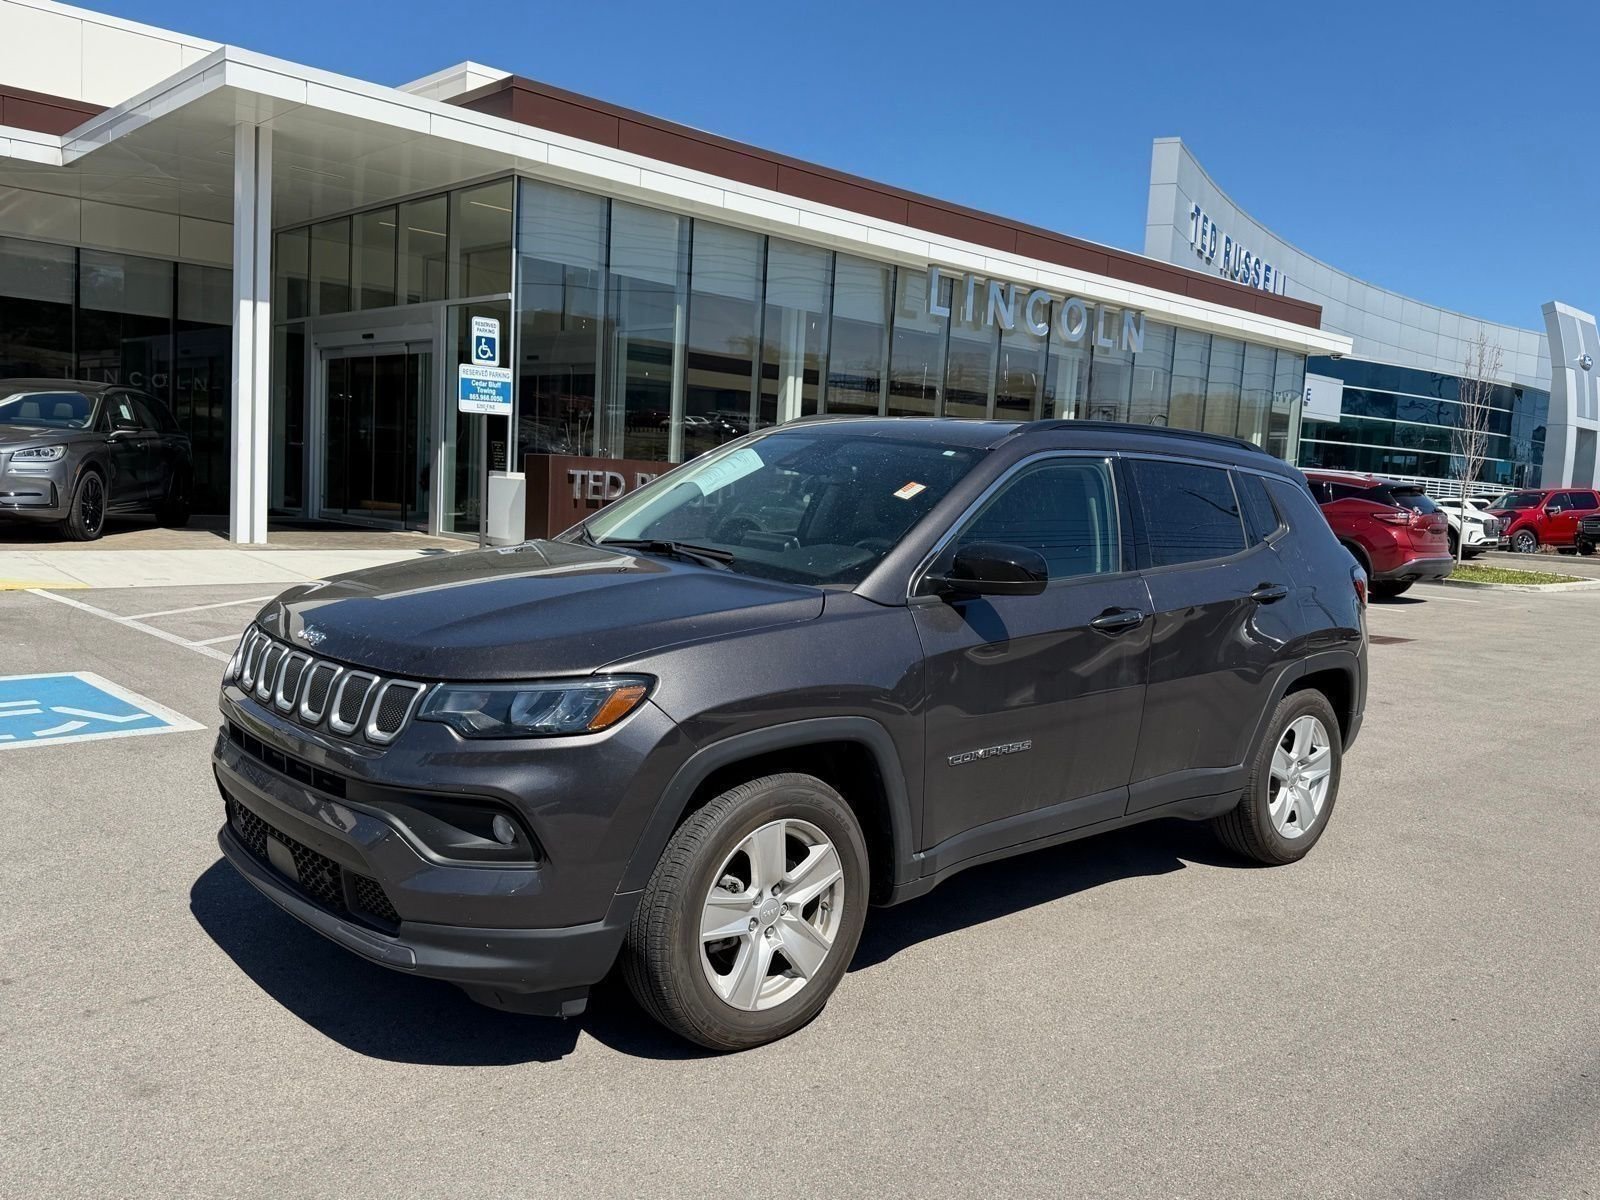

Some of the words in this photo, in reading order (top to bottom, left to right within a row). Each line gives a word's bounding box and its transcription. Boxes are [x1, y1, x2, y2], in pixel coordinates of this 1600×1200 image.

[1190, 202, 1217, 259] TED
[926, 264, 1145, 353] LINCOLN
[475, 320, 497, 329] RESERVED
[476, 326, 496, 335] PARKING
[462, 368, 488, 377] RESERVED
[489, 370, 510, 380] PARKING
[471, 379, 487, 387] Cedar
[488, 381, 502, 389] Bluff
[477, 386, 496, 396] Towing
[567, 469, 626, 500] TED
[947, 739, 1032, 767] COMPASS
